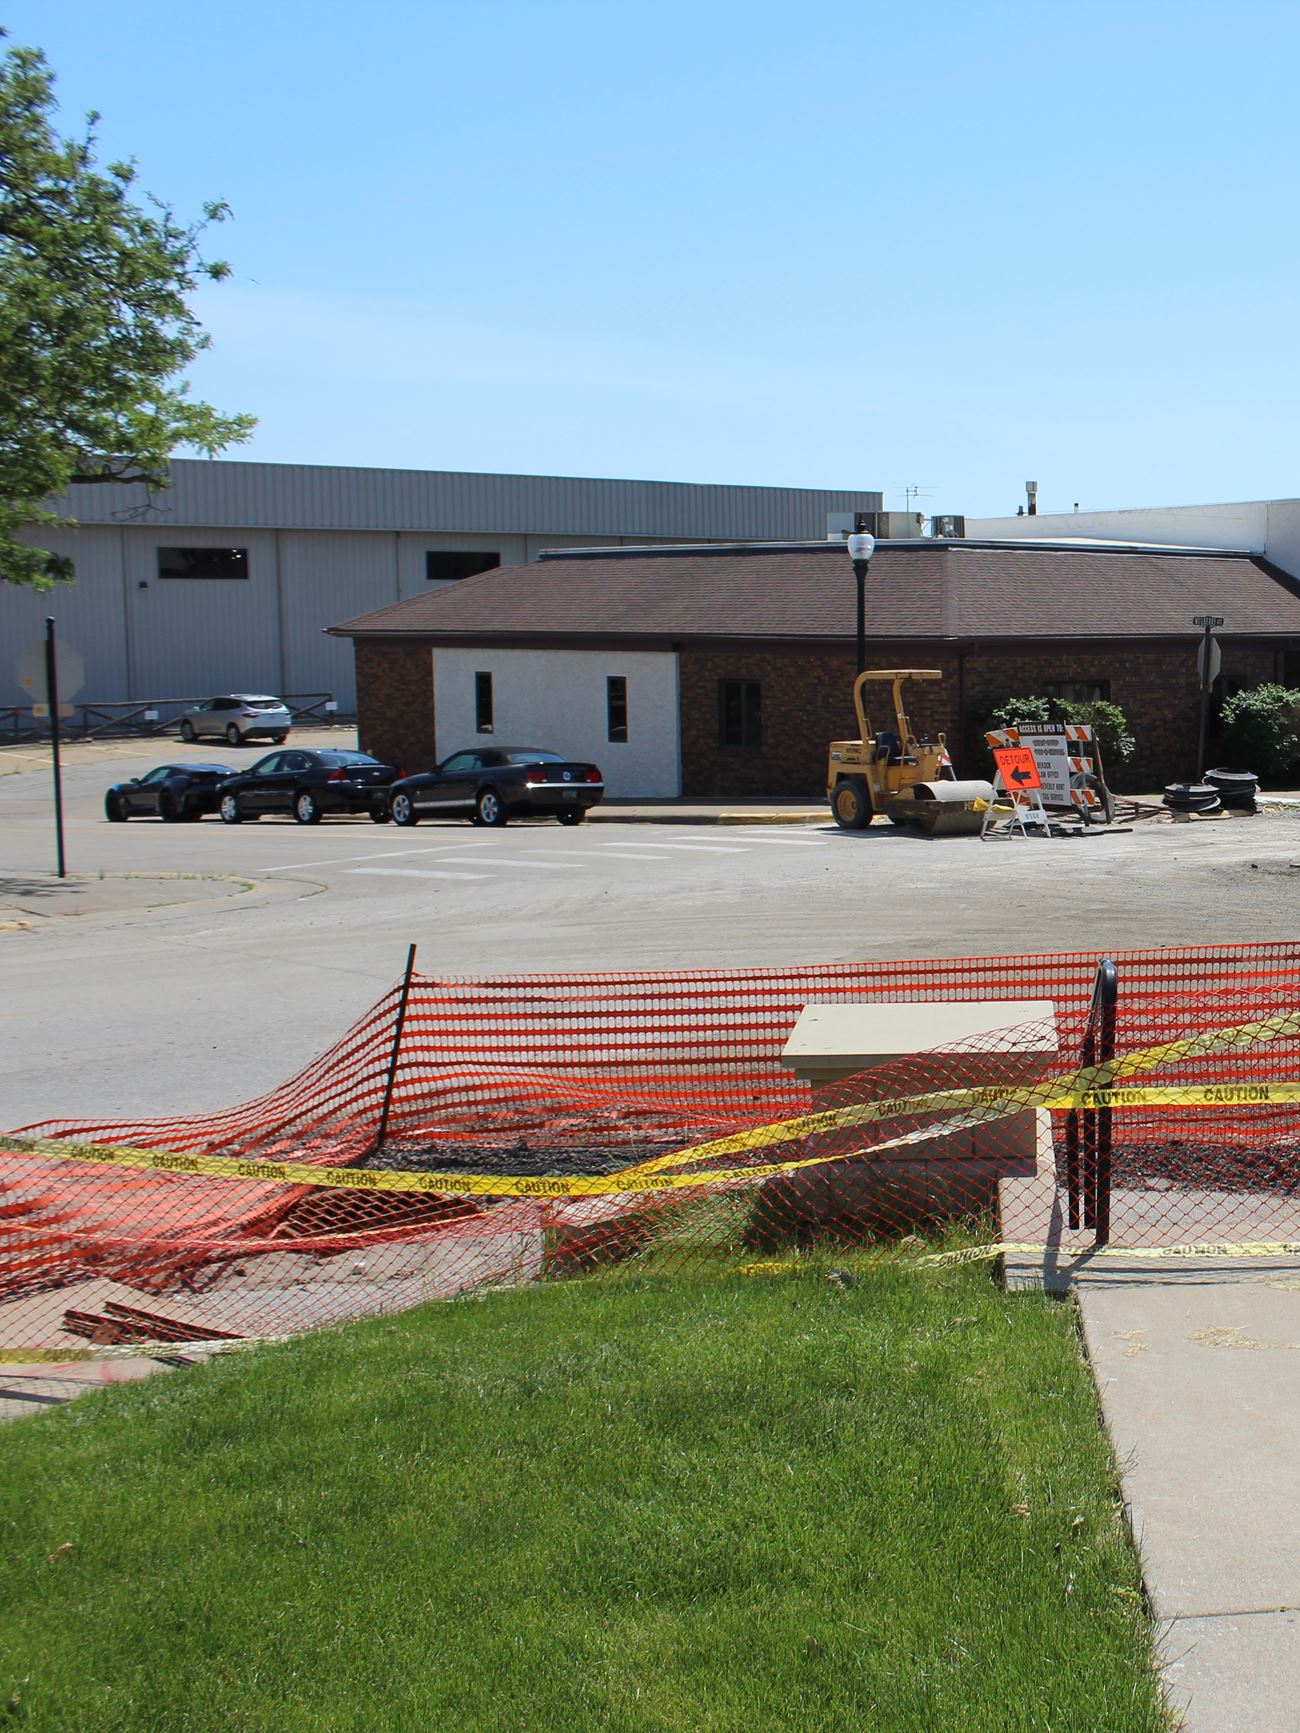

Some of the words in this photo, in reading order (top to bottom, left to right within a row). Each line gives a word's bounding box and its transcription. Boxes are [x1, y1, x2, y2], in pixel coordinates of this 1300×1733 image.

[1019, 725, 1036, 733] ACCESS
[1043, 725, 1056, 733] OPEN
[1000, 754, 1030, 766] DETOUR
[1081, 1090, 1147, 1106] CAUTION
[1203, 1086, 1269, 1101] CAUTION
[237, 1164, 286, 1179] CAUTION
[325, 1171, 377, 1186] CAUTION
[418, 1176, 472, 1193] CAUTION
[513, 1178, 571, 1194] CAUTION
[616, 1177, 675, 1192] CAUTION
